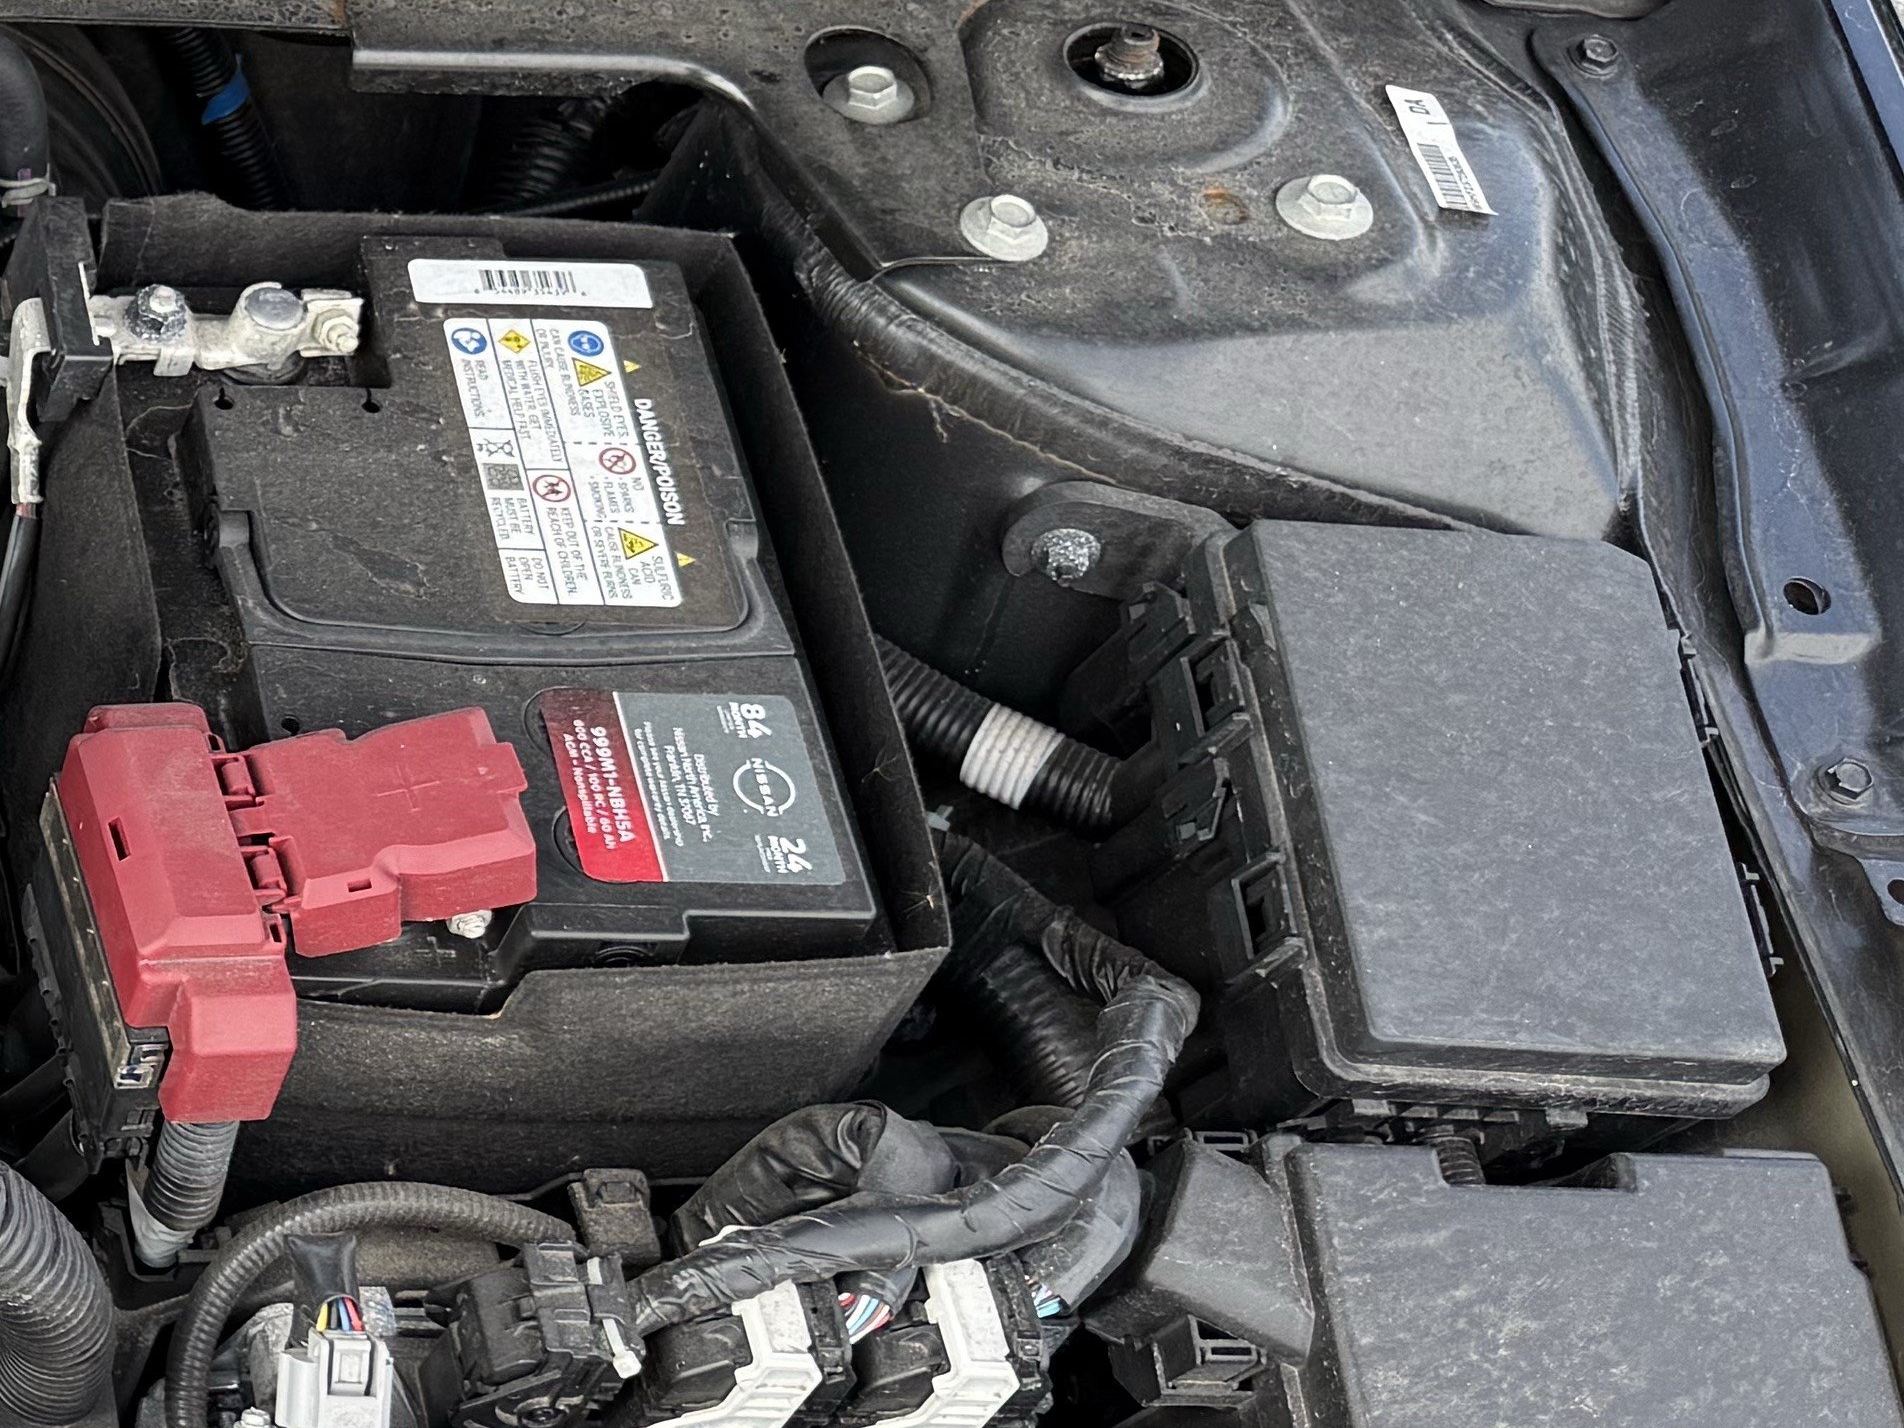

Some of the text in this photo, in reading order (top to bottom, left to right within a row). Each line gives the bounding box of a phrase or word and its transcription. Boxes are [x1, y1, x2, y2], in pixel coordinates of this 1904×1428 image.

[548, 328, 562, 344] CAN
[473, 359, 488, 380] READ
[552, 347, 569, 371] CAUSE
[500, 359, 519, 394] MEDICAL
[510, 397, 525, 418] HELP
[513, 359, 528, 380] WITH
[527, 414, 541, 429] GET
[577, 389, 595, 417] GASES
[604, 381, 622, 412] SHIELD
[526, 360, 563, 462] FLUSH EYES IMMEDIATELY
[591, 389, 615, 437] EXPLOSIVE
[632, 398, 685, 525] DANGER/POISON
[587, 480, 607, 518] SMOKING
[601, 481, 620, 513] FLAMES
[616, 481, 635, 512] SPARKS
[630, 477, 644, 491] NO
[502, 496, 521, 533] MUST BE
[515, 497, 535, 535] BATTERY
[545, 507, 562, 536] REACH
[553, 537, 565, 548] OF
[558, 507, 587, 580] KEEP OUT OF THE
[603, 526, 619, 552] CAUSE
[517, 556, 533, 579] OPEN
[530, 557, 548, 589] DO NOT
[627, 567, 642, 585] CAN
[639, 561, 655, 583] ACID
[650, 555, 673, 600] SULFURIC
[728, 701, 749, 738] MONTH
[738, 703, 774, 738] 84
[578, 741, 595, 762] CCA
[671, 727, 690, 757] Nissan
[562, 733, 578, 757] AGM
[570, 767, 598, 833] Nonspillable
[586, 772, 602, 791] 100
[589, 726, 636, 842] 999M1-NBH5A
[680, 758, 697, 784] North
[693, 753, 719, 816] Distributed by
[750, 757, 778, 816] NISSAN
[766, 835, 789, 873] MONTH
[777, 837, 813, 872] 24
